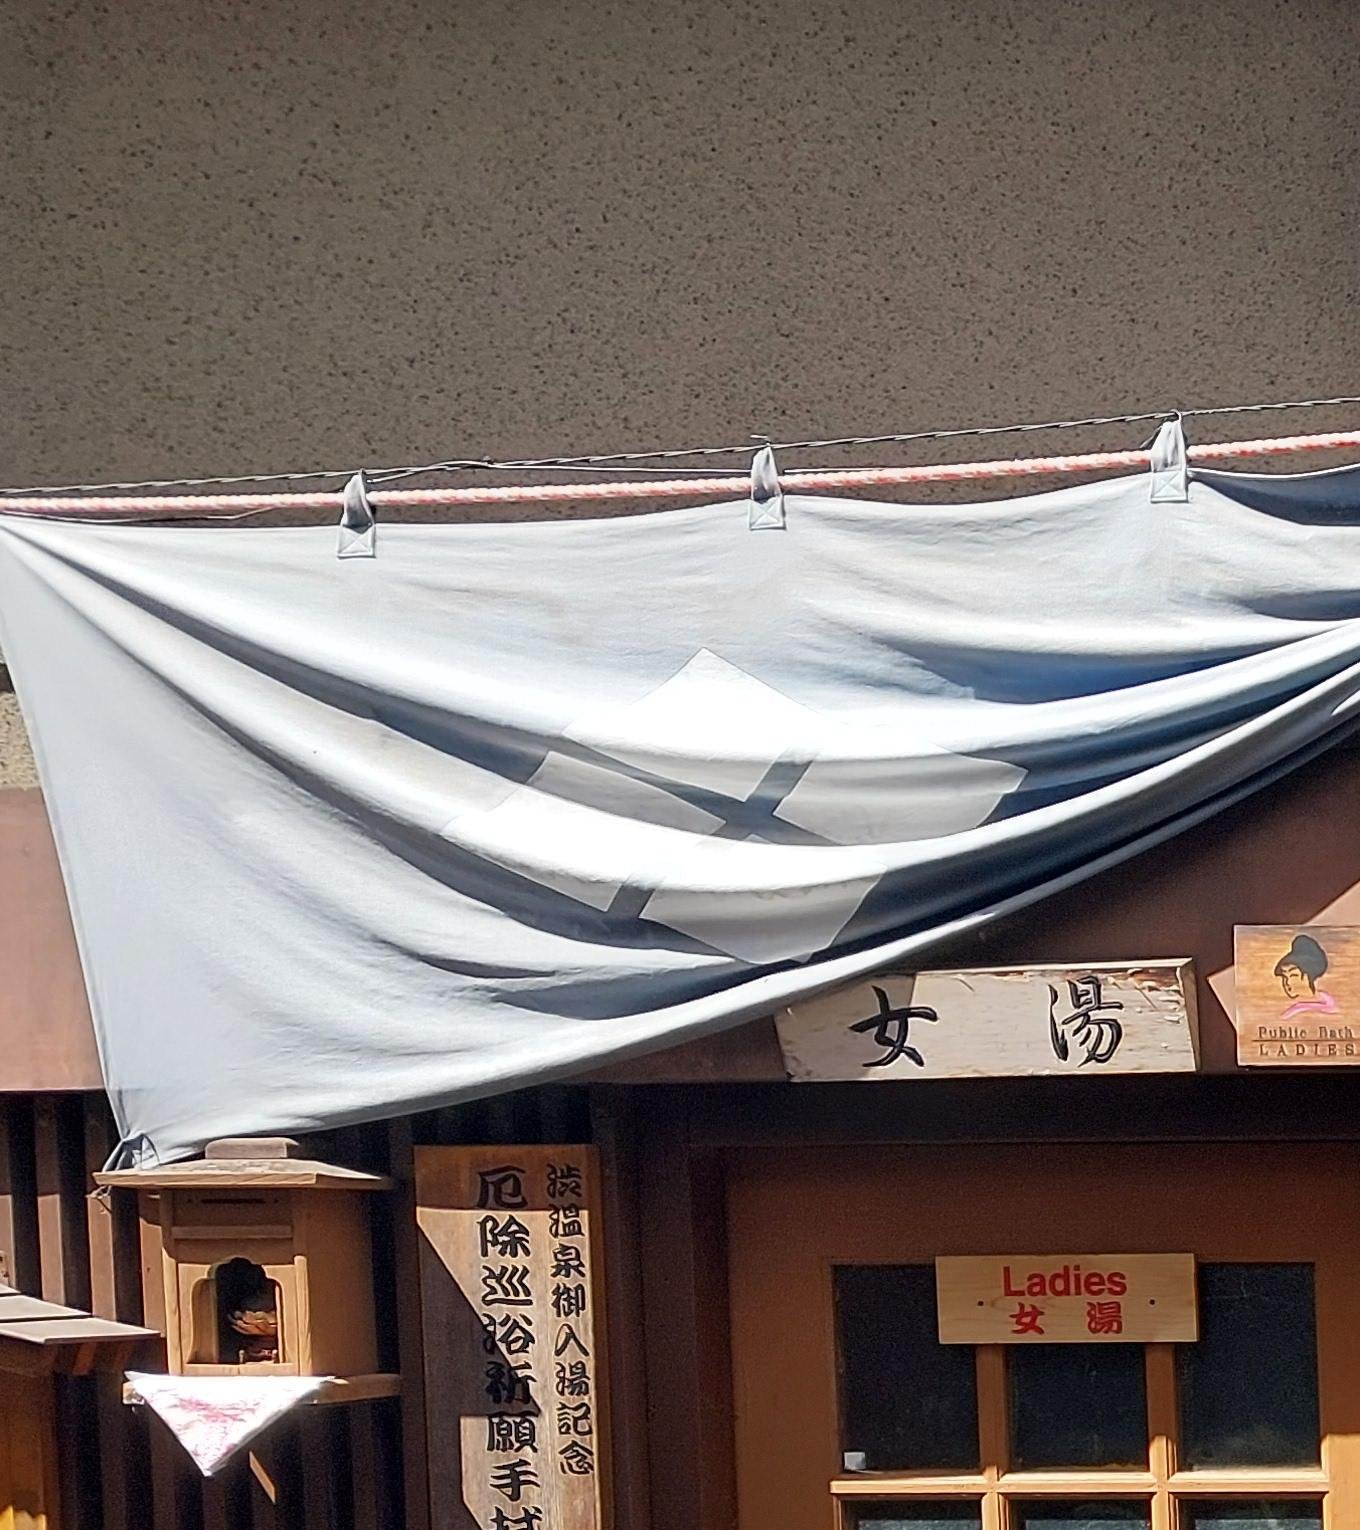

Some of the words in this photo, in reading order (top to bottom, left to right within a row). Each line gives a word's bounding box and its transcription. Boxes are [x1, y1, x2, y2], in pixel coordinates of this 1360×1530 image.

[848, 974, 1125, 1068] 女湯
[1258, 1026, 1307, 1039] Public
[1318, 1026, 1354, 1039] Bath
[1259, 1043, 1356, 1056] LADIES
[1002, 1264, 1128, 1298] Ladies
[546, 1163, 595, 1476] 渋温泉御入湯記念
[1009, 1301, 1124, 1336] 女湯
